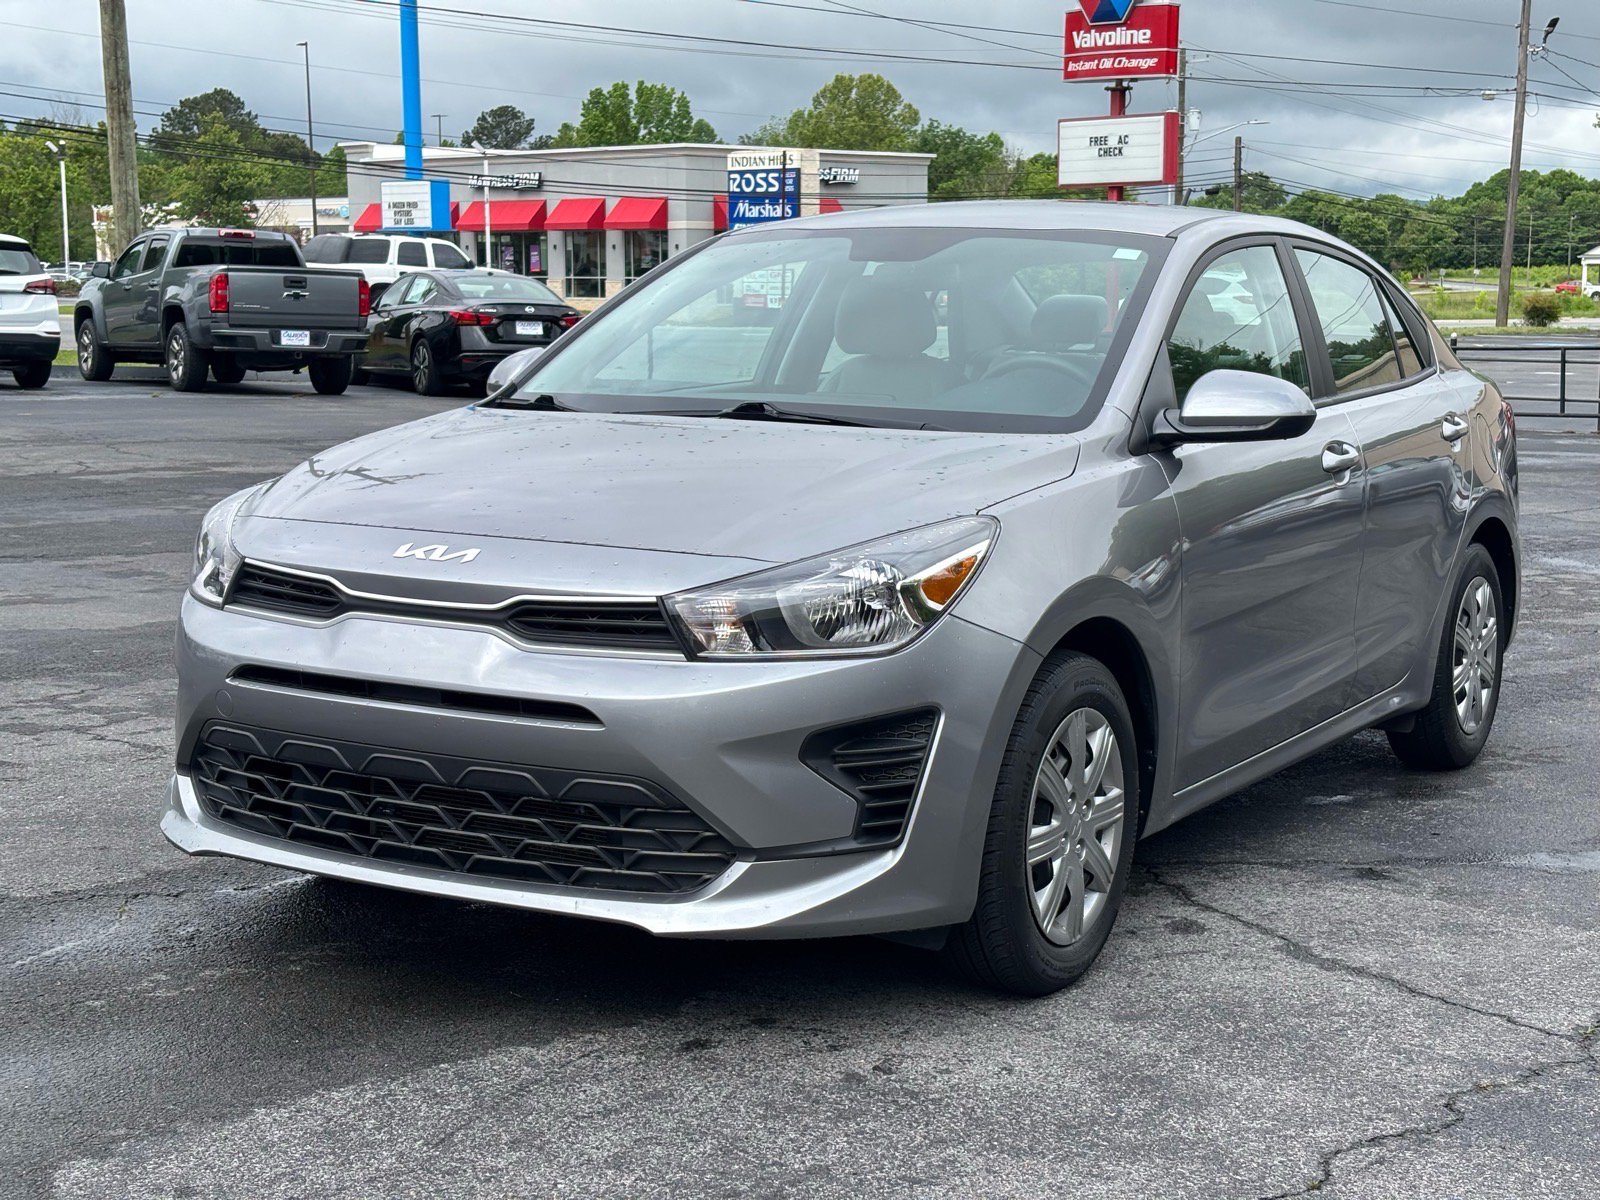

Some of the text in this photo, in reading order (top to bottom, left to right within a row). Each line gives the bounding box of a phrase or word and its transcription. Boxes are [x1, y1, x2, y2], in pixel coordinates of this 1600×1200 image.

[1072, 27, 1151, 48] Valvoline
[1067, 56, 1158, 71] Instant Oil Change
[1089, 135, 1129, 146] FREE AC
[1098, 147, 1123, 157] CHECK
[731, 156, 766, 167] INDIAN
[730, 173, 780, 192] ROSS
